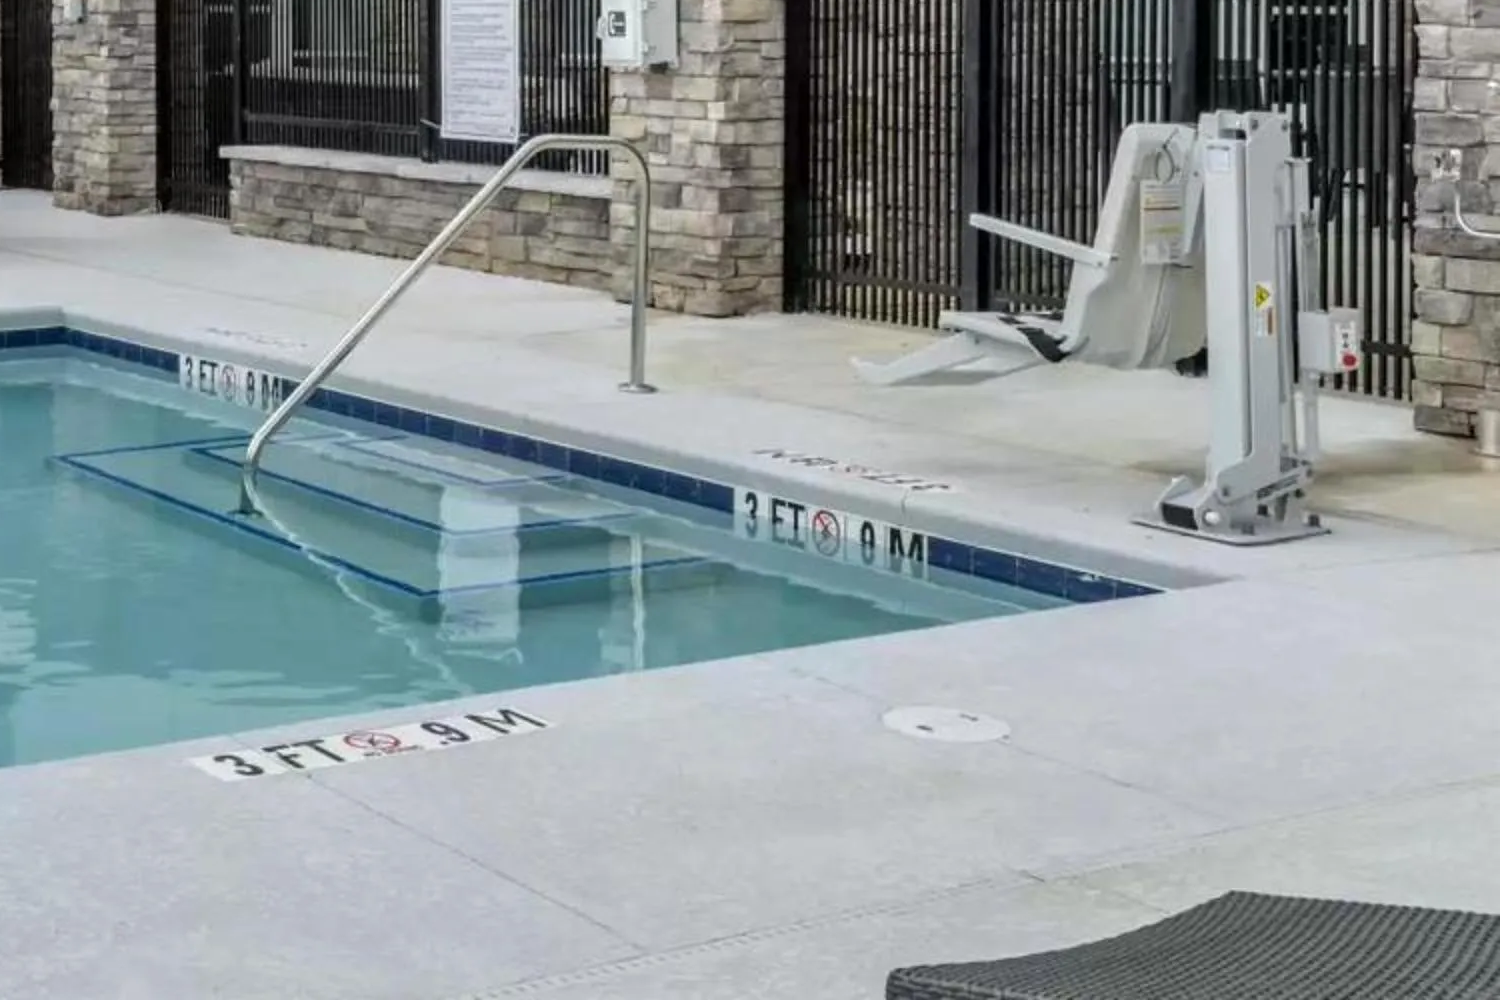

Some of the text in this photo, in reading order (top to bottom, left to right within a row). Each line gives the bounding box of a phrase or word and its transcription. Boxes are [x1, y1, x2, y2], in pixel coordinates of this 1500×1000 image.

[213, 754, 264, 777] 3
[262, 738, 345, 770] FT
[464, 708, 546, 735] M
